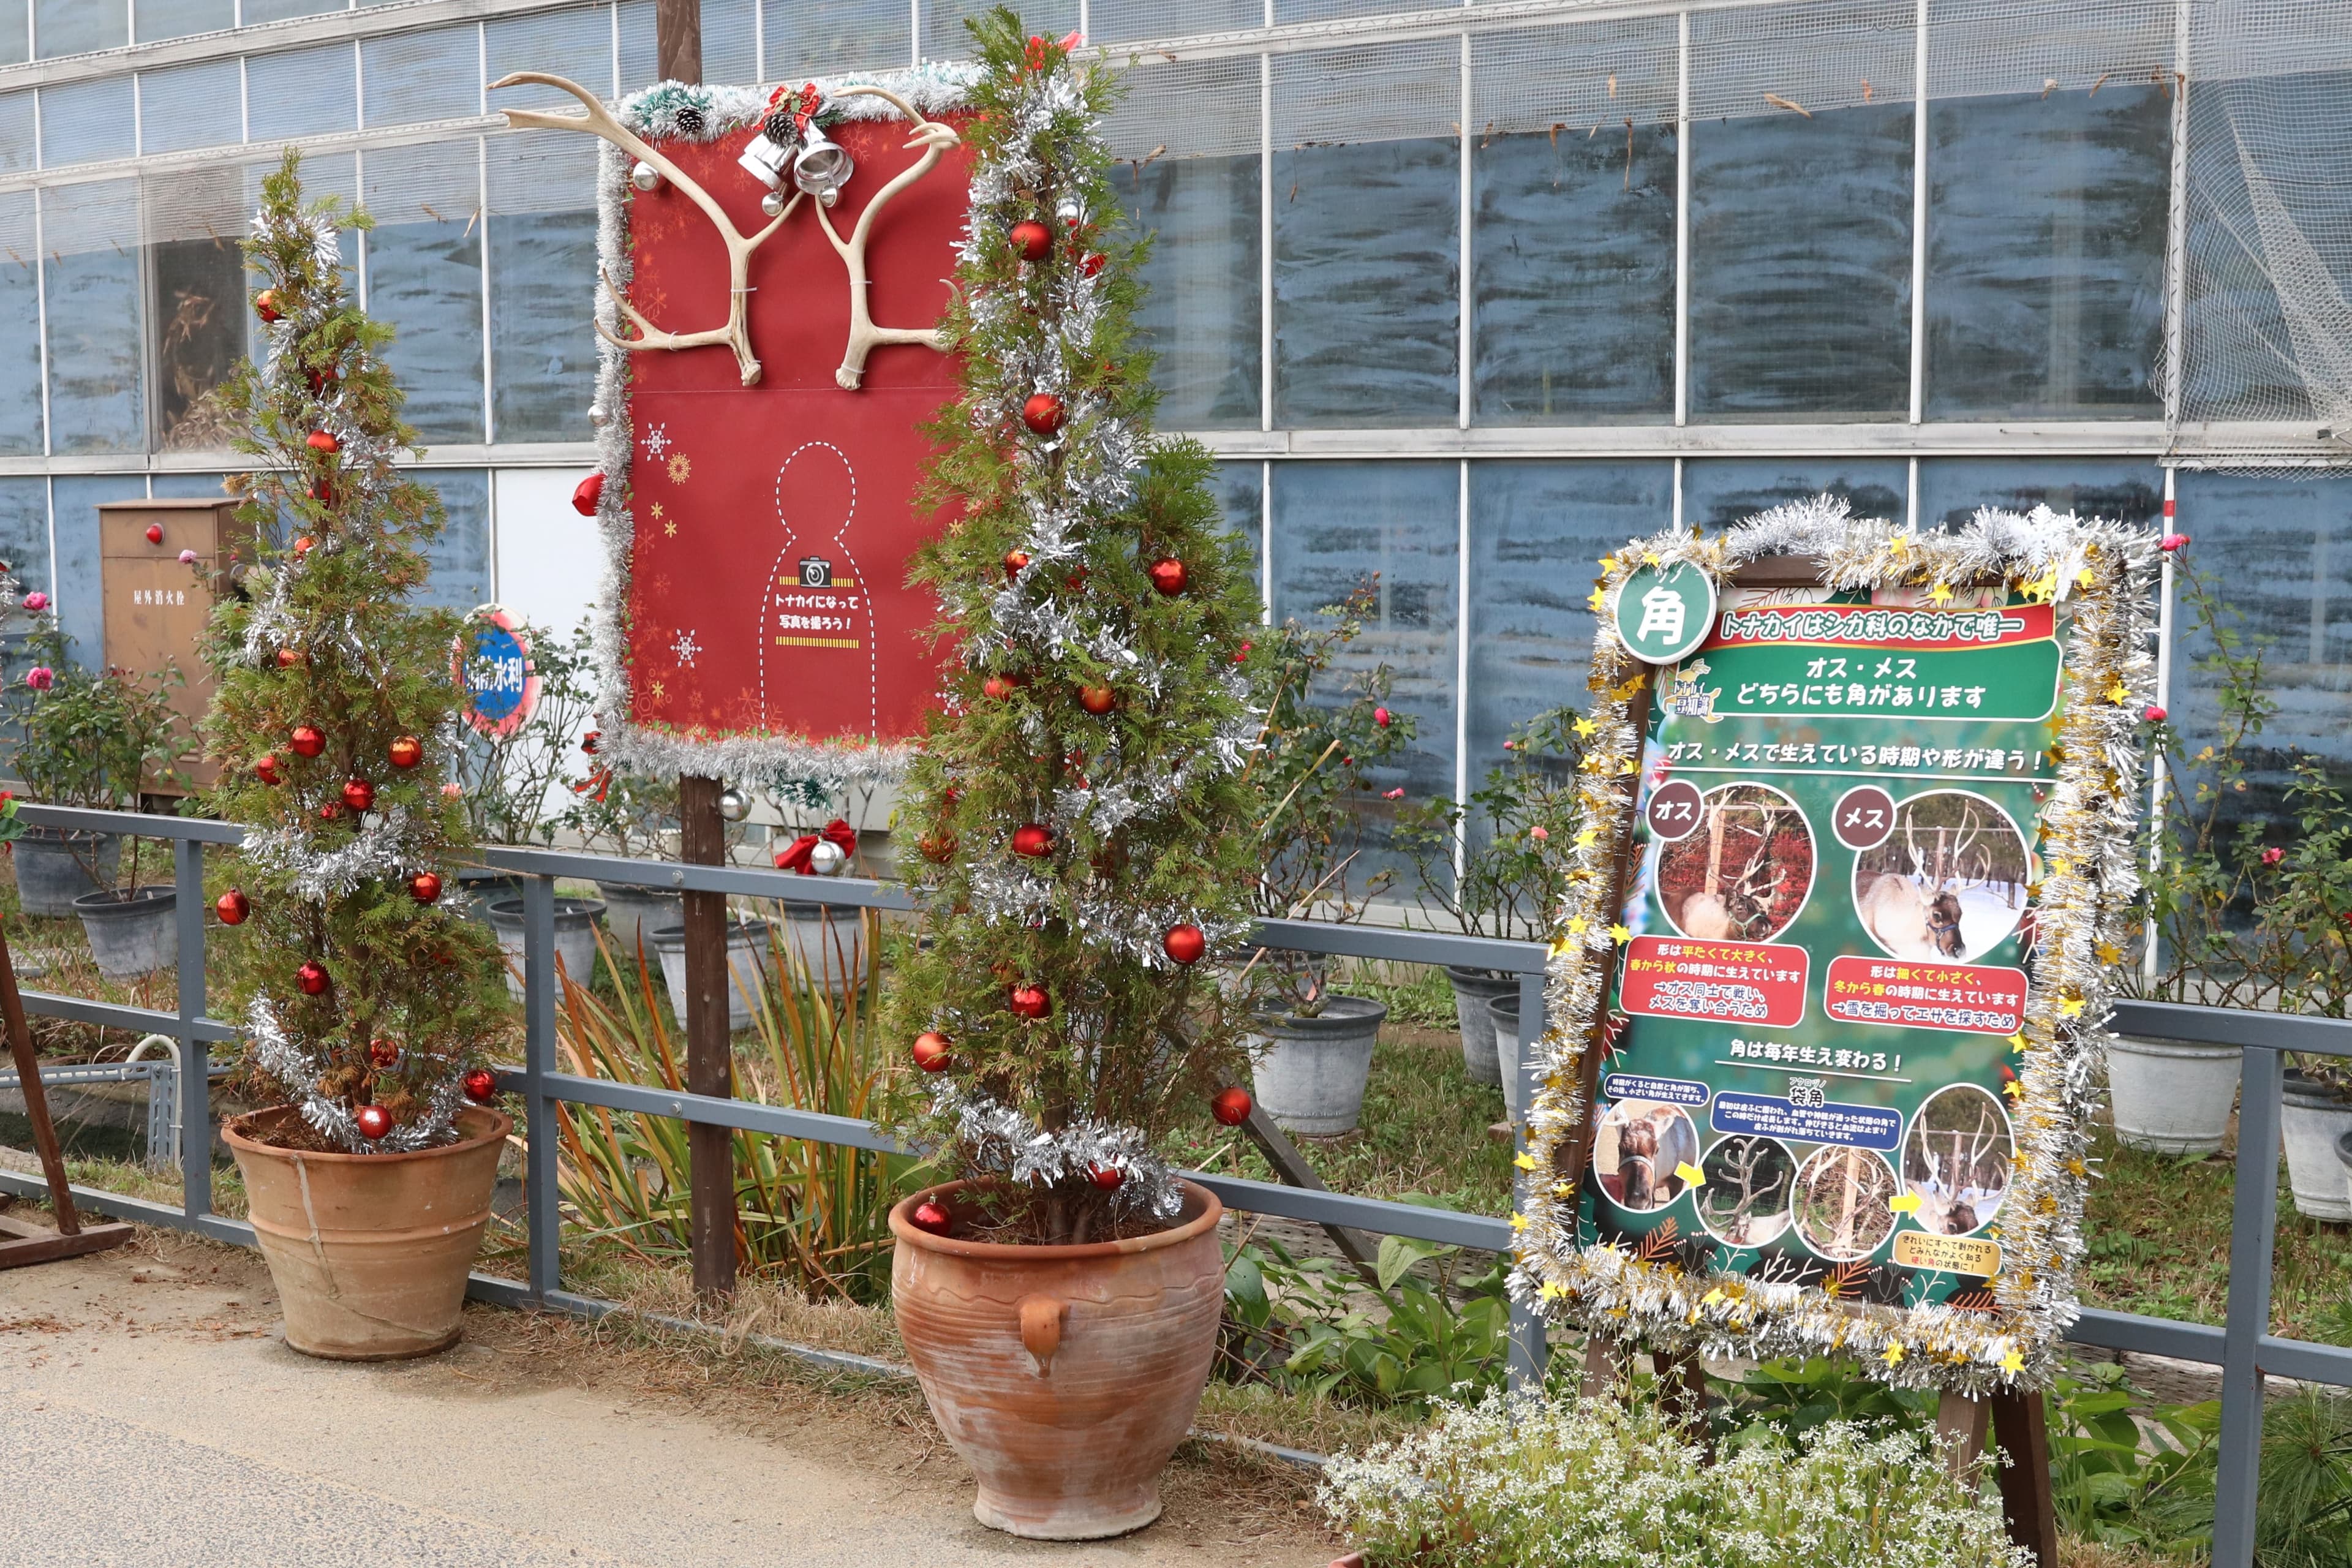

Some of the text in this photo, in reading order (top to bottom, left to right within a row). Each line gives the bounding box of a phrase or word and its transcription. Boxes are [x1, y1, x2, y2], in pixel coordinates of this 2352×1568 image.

[134, 590, 184, 605] 屋外消火栓
[775, 593, 859, 609] トナカイになって
[779, 614, 851, 630] 写真を撮ろう！
[1637, 586, 1686, 645] 角
[1721, 611, 2024, 641] トナカイはシカ科のなかで唯一
[1806, 657, 1917, 679] オス・メス
[1673, 681, 1705, 695] トナカイ
[1736, 682, 1986, 709] どちらにも角があります
[1675, 695, 1711, 717] 豆知識
[1668, 741, 2042, 771] オス・メスで生えている時期や形が違う！
[1655, 800, 1693, 821] オス
[1844, 807, 1885, 830] メス
[1657, 943, 1773, 964] 形は平たくて大きく、
[1630, 959, 1801, 983] 春から秋の時期に生えています
[1870, 965, 1981, 986] 形は細くて小さく、
[1833, 980, 2019, 1007] 冬から春の時期に生えています
[1649, 994, 1768, 1019] メスを奪い合うため
[1845, 1001, 2016, 1029] 雪を掘ってエサを探すため
[1730, 1038, 1902, 1072] 角は毎年生え変わる！
[1612, 1078, 1700, 1094] 時期がくると自然と角が落ち、
[1789, 1077, 1827, 1088] フクロヅノ
[1607, 1086, 1705, 1102] その後、小さい角が生えてきます。
[1790, 1086, 1825, 1108] 袋角
[1902, 1235, 1991, 1254] きれいにすべて剥がれる
[1909, 1246, 1982, 1262] とみんながよく知る
[1911, 1256, 1974, 1271] 硬い角の状態に！
